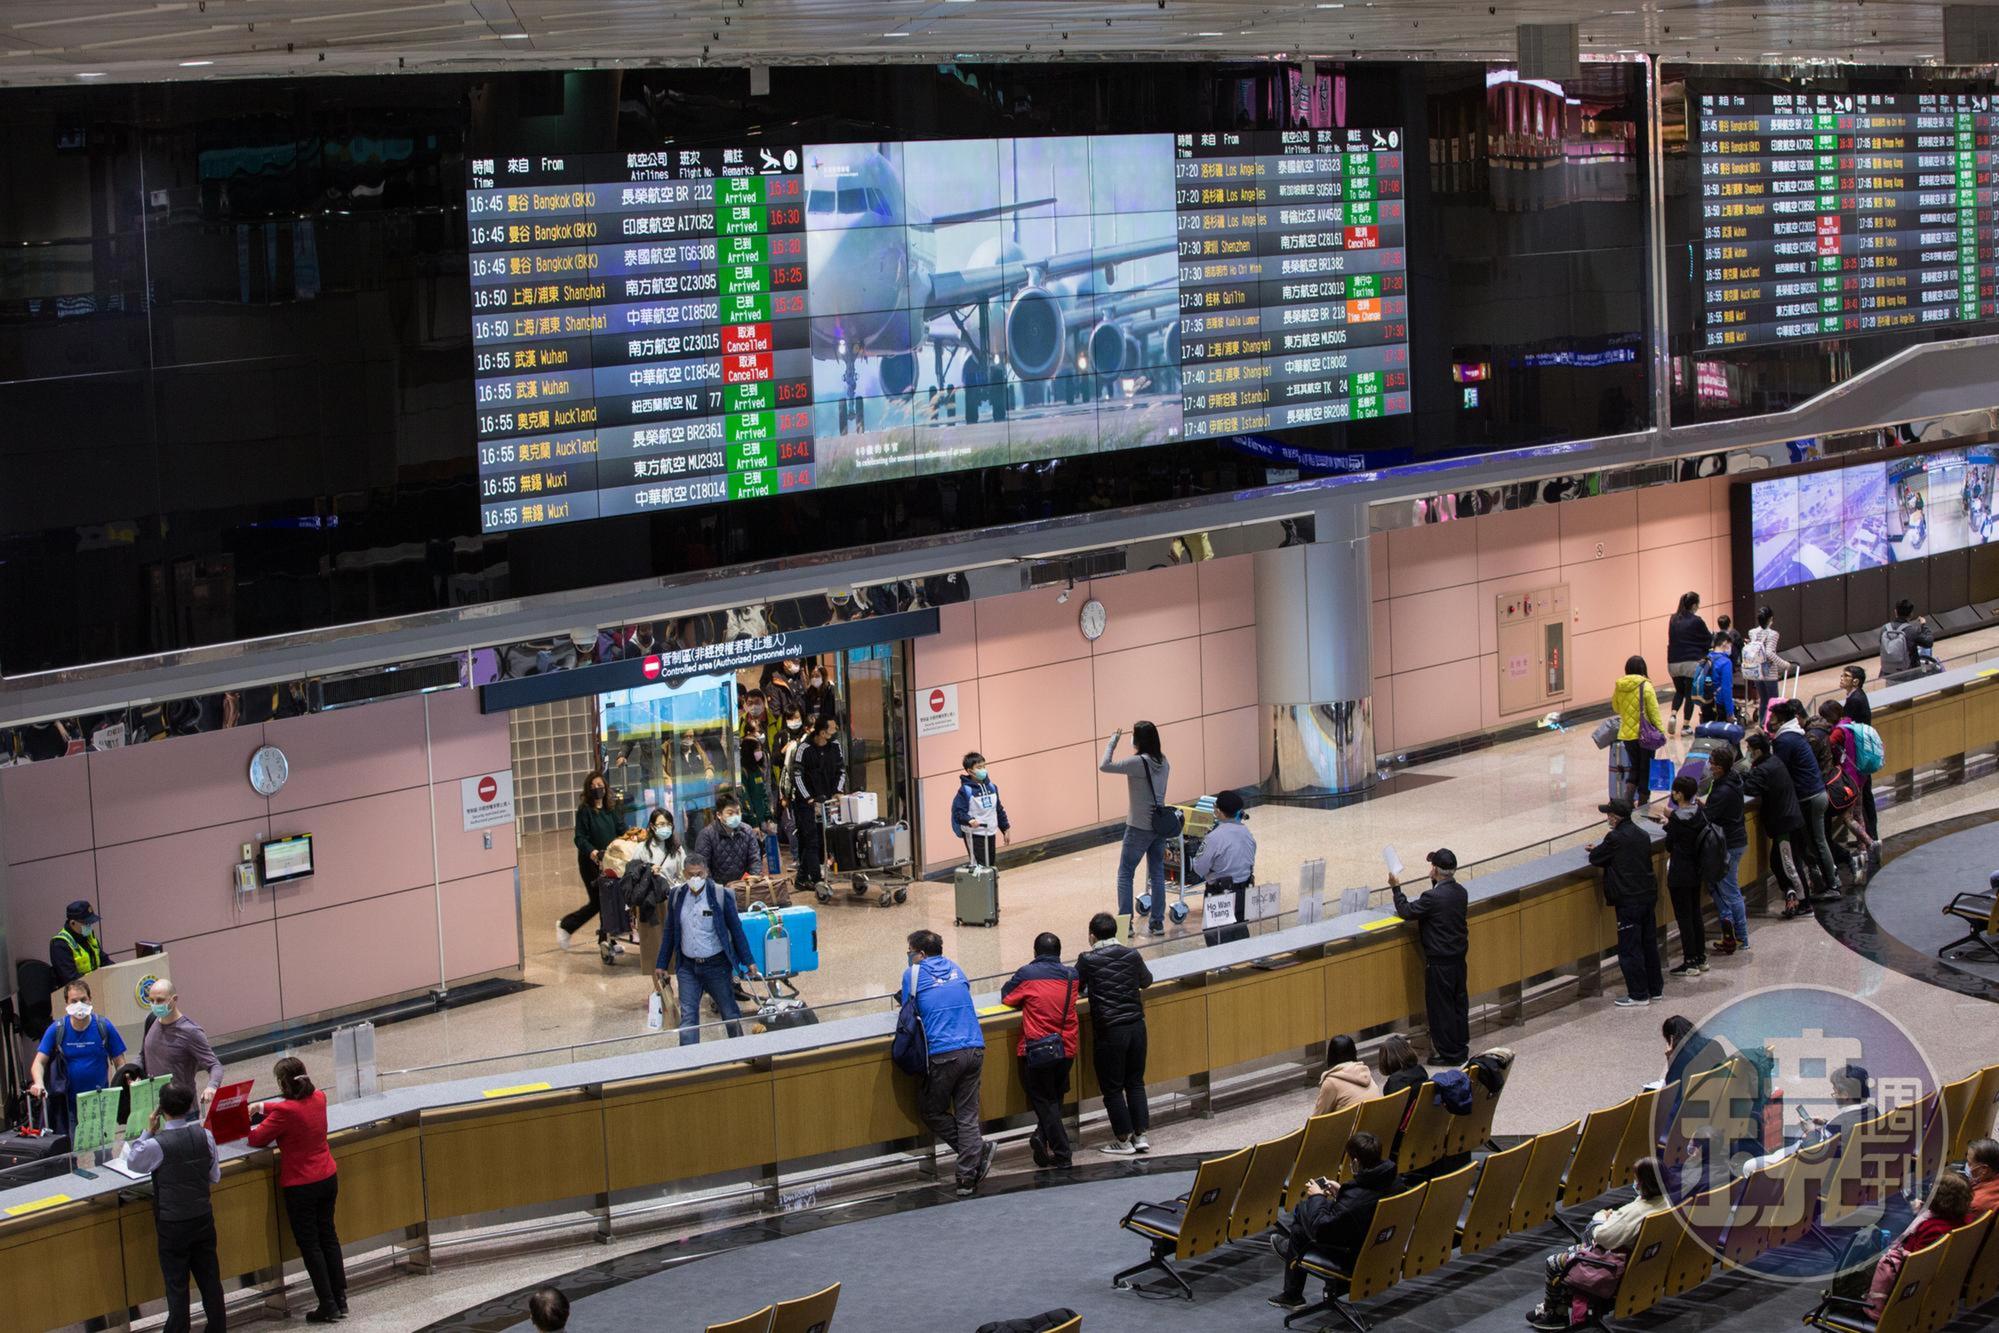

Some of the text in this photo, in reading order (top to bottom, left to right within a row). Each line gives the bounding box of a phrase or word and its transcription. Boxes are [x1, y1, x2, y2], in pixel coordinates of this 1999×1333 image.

[1178, 134, 1239, 147] 時間 來自 From
[473, 150, 742, 175] 時間 來自 From 航空公司 班次 備註
[1176, 160, 1314, 177] 17:20 Los Angeles 泰國航空
[474, 178, 494, 188] Time
[631, 170, 669, 180] Airlines
[680, 168, 701, 178] Flight
[722, 166, 754, 176] Remarks
[731, 179, 749, 191] 已到
[470, 195, 503, 212] 16:45
[508, 195, 529, 212] 曼谷
[622, 187, 674, 204] 長榮航空
[676, 186, 688, 200] BR
[694, 185, 712, 200] 212
[725, 191, 756, 204] Arrived
[1177, 187, 1266, 203] 17:20 Los Angeles
[733, 208, 750, 220] 已到
[472, 227, 504, 243] 16:45
[509, 226, 530, 243] 曼谷
[623, 217, 675, 235] 印度航空
[678, 215, 714, 231] AI7052
[770, 210, 800, 225] 16:30
[726, 220, 757, 233] Arrived
[1178, 216, 1200, 229] 17:20
[734, 238, 751, 250] 已到
[1179, 233, 1343, 255] 17:30 Shenzhen 南方航空 CZ8161
[473, 258, 506, 276] 16:45
[510, 257, 531, 274] 曼谷
[624, 247, 676, 266] 泰國航空
[679, 245, 715, 261] TG6308
[728, 250, 758, 262] Arrived
[735, 267, 753, 279] 已到
[1180, 267, 1202, 280] 17:30
[1282, 258, 1317, 274] 長榮航空
[474, 268, 802, 307] 16:50 上海/浦東 Shanghai 南方航空 CZ3095 15:25
[729, 279, 760, 292] Arrived
[736, 296, 754, 308] 已到
[1180, 284, 1344, 307] 17:30 桂林 南方航空 CZ3019
[730, 308, 761, 321] Arrived
[1181, 307, 1345, 333] 17:35 長榮航空 218
[476, 321, 508, 339] 16:50
[513, 316, 560, 337] 上海/浦東
[566, 314, 607, 333] Shanghai
[627, 306, 679, 325] 中華航空
[682, 305, 718, 321] CI8502
[738, 327, 755, 339] 取消
[727, 339, 767, 352] Cancelled
[1182, 345, 1204, 359] 17:40
[477, 335, 719, 371] 16:55 武漢 Wuhan 南方航空 CZ3015
[739, 356, 756, 367] 取消
[728, 367, 768, 381] Cancelled
[1183, 371, 1205, 384] 17:40
[1285, 358, 1320, 373] 中華航空
[479, 364, 720, 402] 16:55 武漢 Wuhan 中華航空 CI8542
[740, 385, 758, 396] 已到
[1184, 381, 1348, 410] 17:40 Istanbul TK 24
[480, 385, 807, 433] 16:55 奧克蘭 Auckland 紐西蘭航空 NZ 77 16:25
[734, 396, 765, 409] Arrived
[742, 414, 759, 426] 已到
[1185, 422, 1206, 436] 17:40
[1242, 414, 1270, 430] Istanbul
[1287, 408, 1322, 424] 長榮航空
[735, 426, 766, 439] Arrived
[482, 447, 514, 465] 16:55
[519, 443, 551, 462] 奧克蘭
[556, 438, 598, 457] Auckland
[633, 425, 685, 447] 長榮航空
[687, 424, 723, 440] BR2361
[743, 444, 760, 456] 已到
[736, 456, 767, 469] Arrived
[483, 444, 809, 496] 16:55 無錫 Wuxi 東方航空 MU2931 16:41
[744, 473, 761, 485] 已到
[738, 485, 769, 498] Arrived
[485, 510, 517, 528] 16:55
[522, 506, 544, 523] 無錫
[548, 502, 569, 519] Wuxi
[635, 486, 687, 507] 中華航空
[690, 483, 726, 500] CI8014
[662, 645, 802, 677] Controlled area (Authorized personnel only)
[1207, 900, 1231, 911] Ho Wan
[1210, 909, 1229, 919] Tsang
